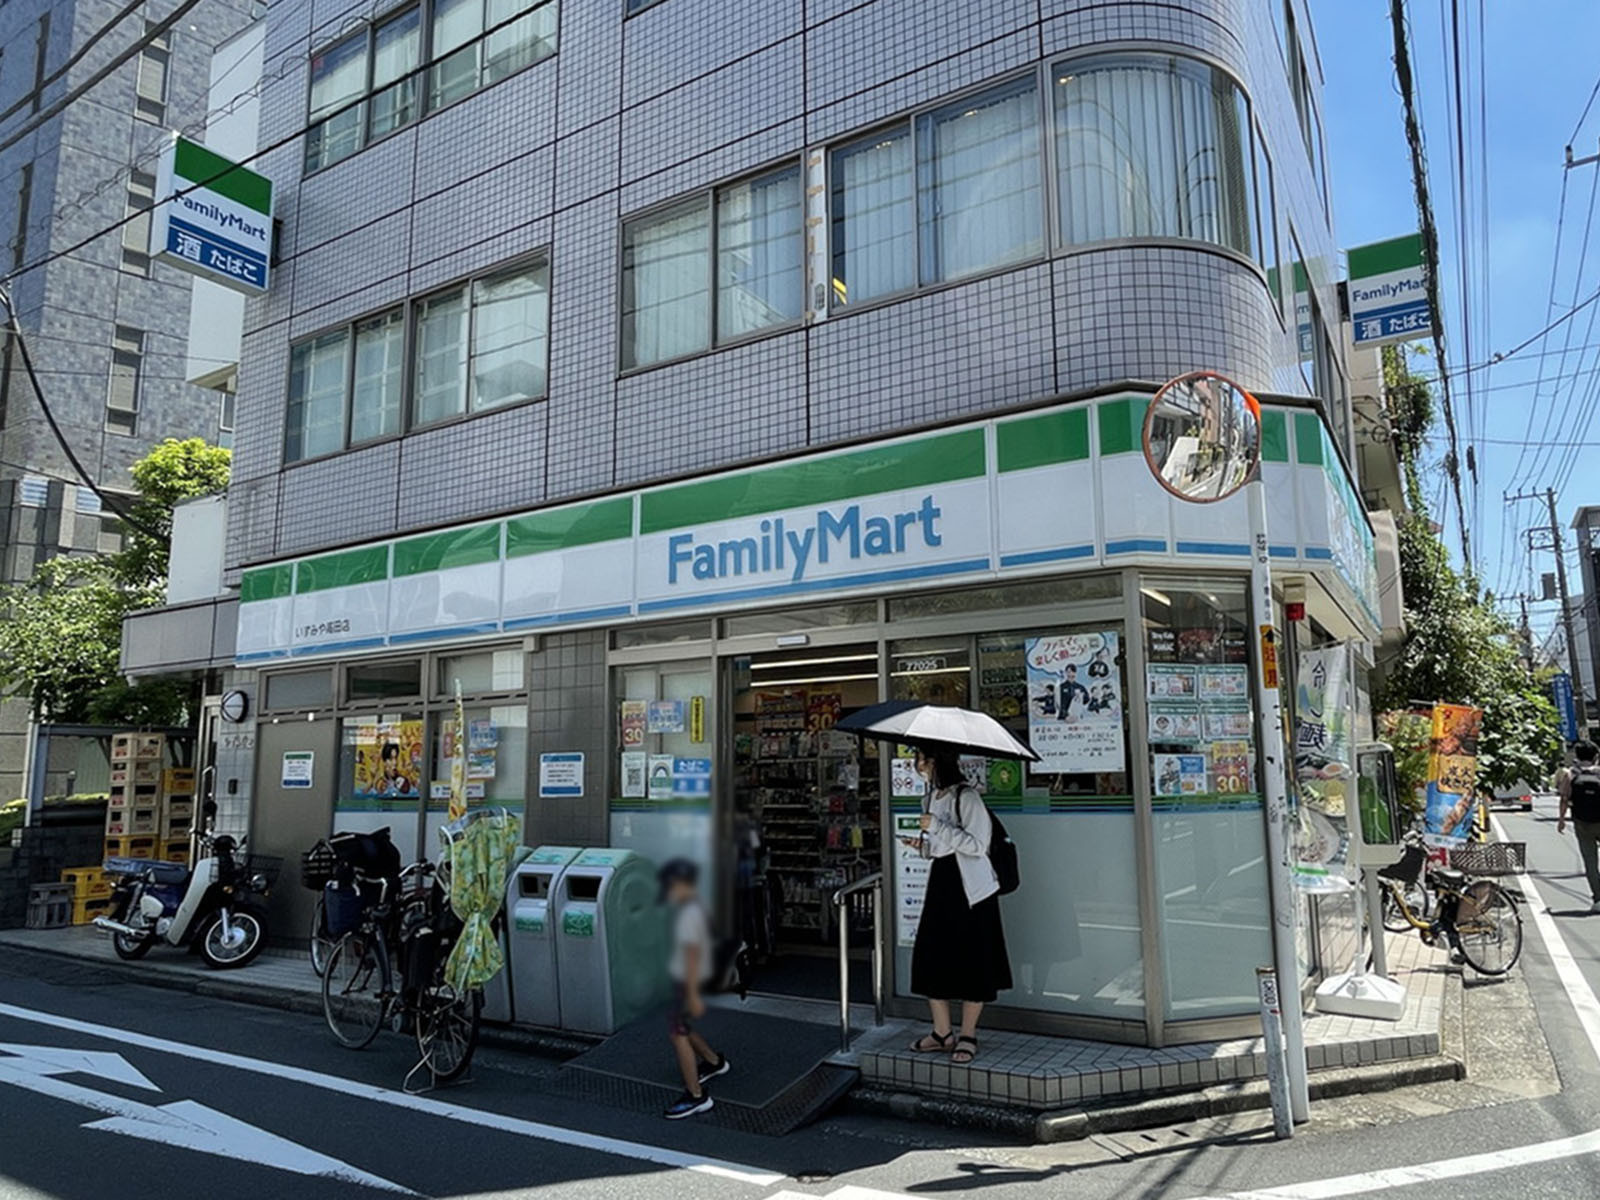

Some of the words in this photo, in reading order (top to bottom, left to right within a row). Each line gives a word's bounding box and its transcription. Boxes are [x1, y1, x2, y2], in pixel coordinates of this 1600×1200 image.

[174, 189, 266, 242] FamilyMart
[176, 232, 202, 262] 酒
[210, 249, 258, 282] たばこ
[1352, 276, 1430, 303] FamilyMar
[1362, 319, 1382, 338] 酒
[1389, 312, 1431, 333] たばこ
[668, 495, 942, 584] FamilyMart
[1216, 775, 1241, 793] 30
